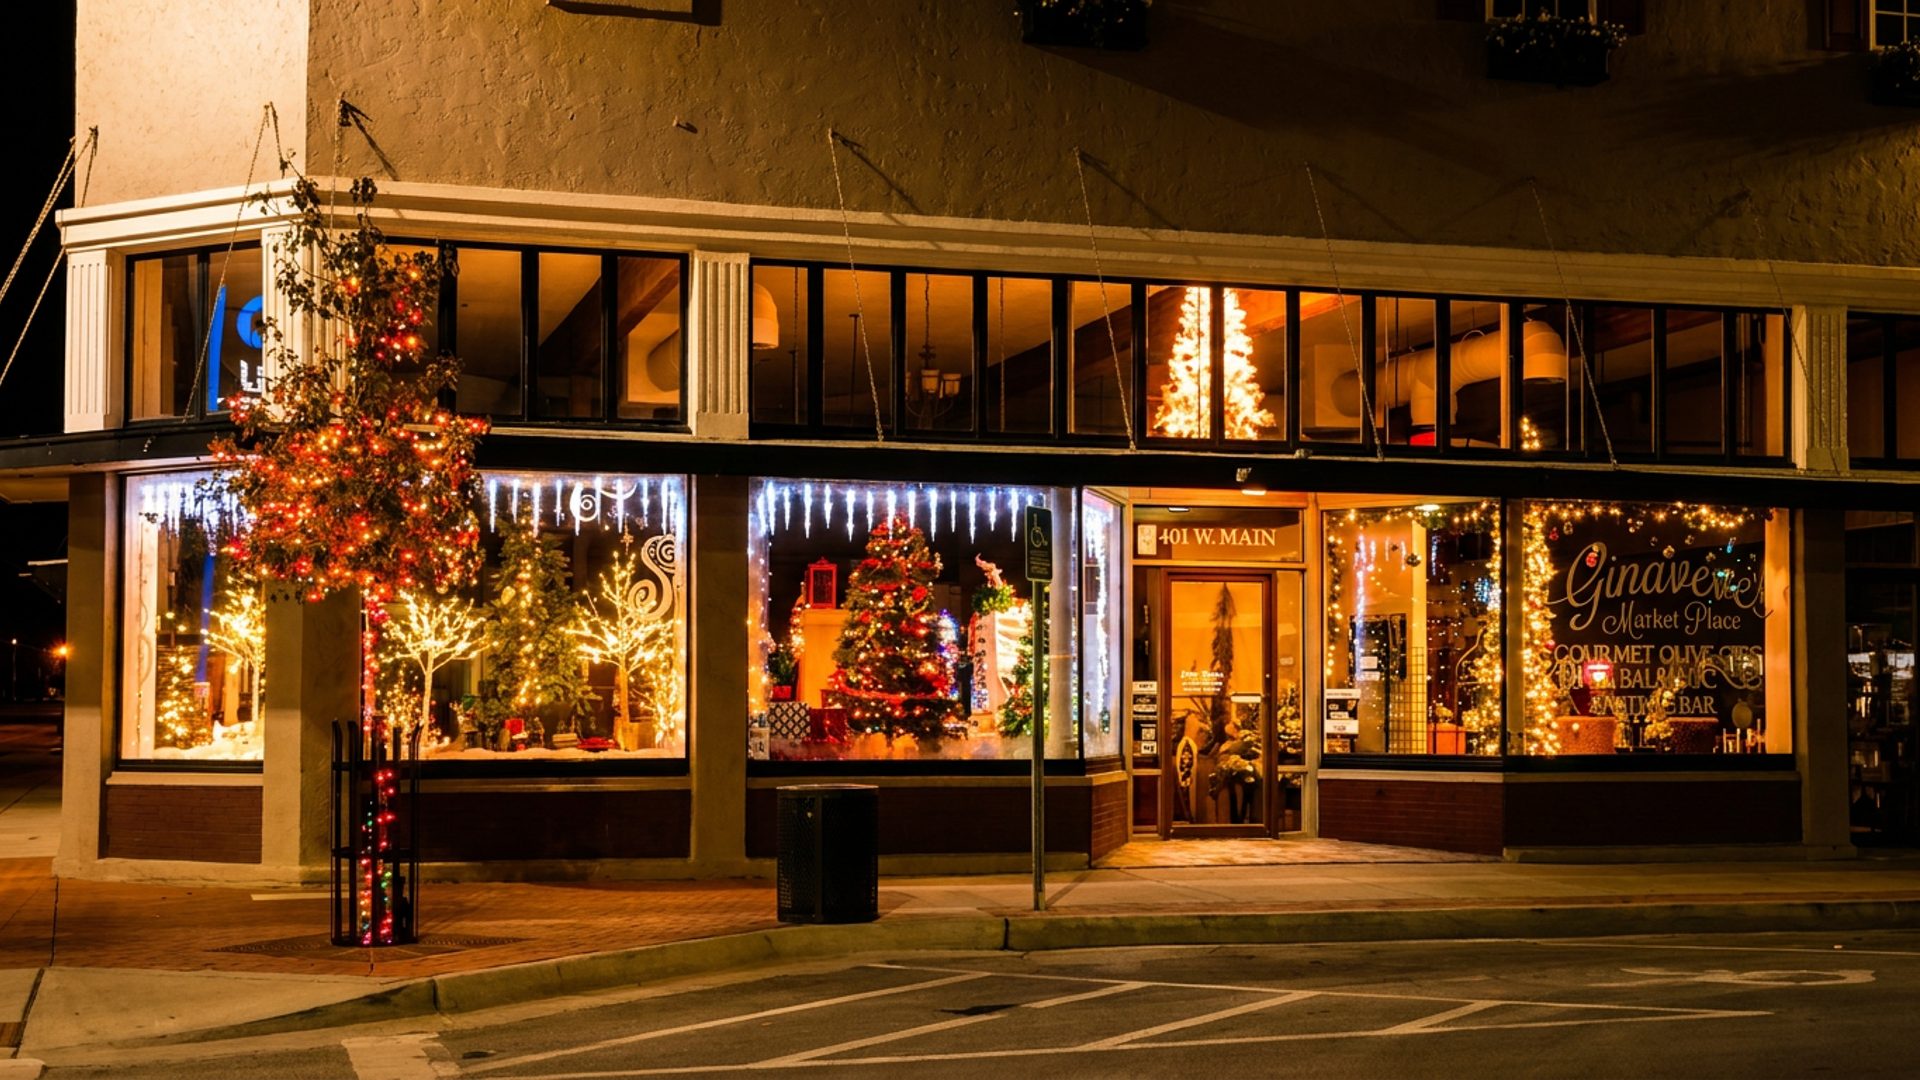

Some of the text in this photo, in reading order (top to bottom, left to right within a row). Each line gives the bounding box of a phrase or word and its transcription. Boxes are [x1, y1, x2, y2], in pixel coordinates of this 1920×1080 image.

[1158, 527, 1277, 547] 401 W. MAIN
[1601, 600, 1742, 640] Market Place
[1553, 644, 1655, 665] GOURMET
[1659, 644, 1714, 665] OLIVE
[1619, 667, 1718, 689] BALSC
[1589, 695, 1718, 715] ATIG BAR
